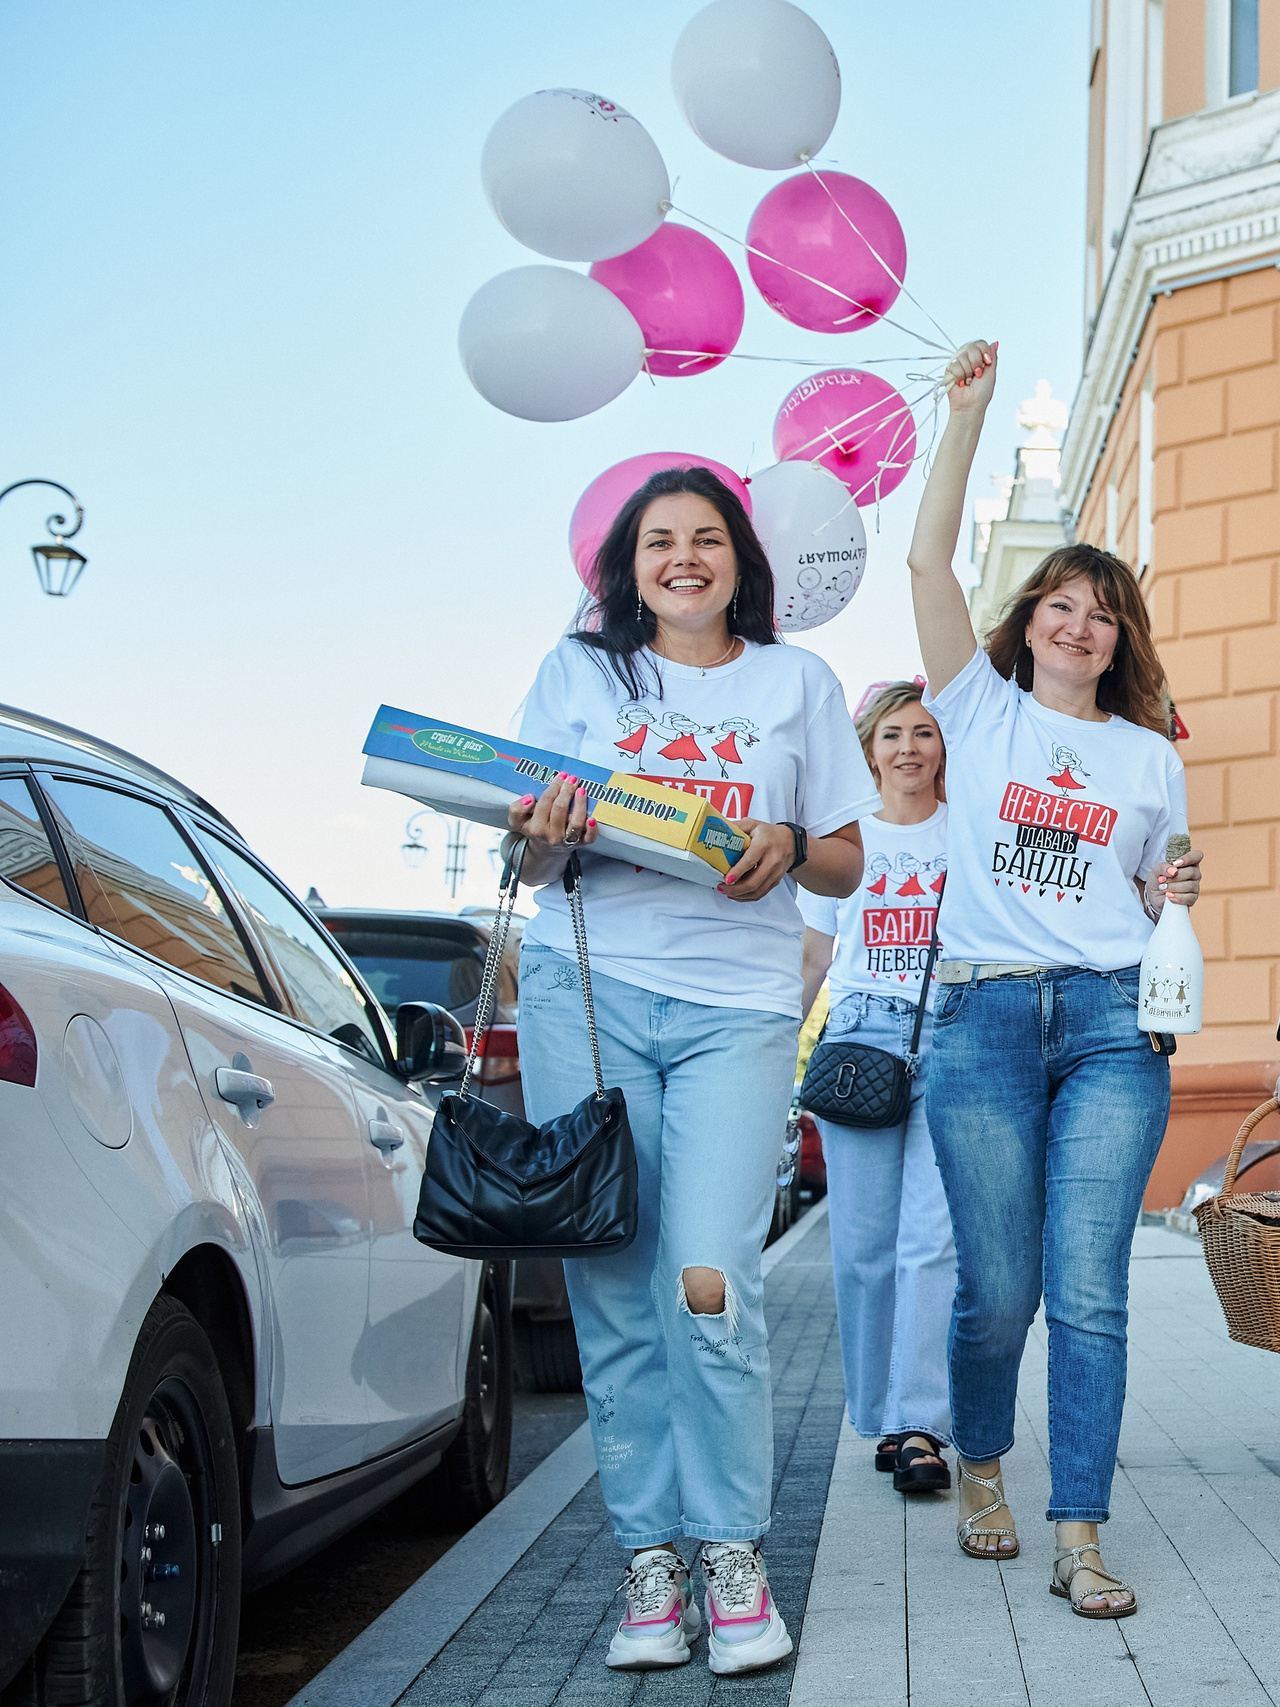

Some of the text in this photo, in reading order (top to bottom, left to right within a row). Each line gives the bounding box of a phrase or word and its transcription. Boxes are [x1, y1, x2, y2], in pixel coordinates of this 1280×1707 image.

[420, 740, 443, 752] Made
[452, 747, 480, 761] Russia
[430, 731, 484, 752] crystal & glass
[624, 793, 677, 821] НАБОР
[1002, 784, 1112, 843] НЕВЕСТА
[1018, 825, 1075, 853] ГЛАВАРЬ
[991, 842, 1092, 890] БАНДЫ
[866, 910, 935, 945] БАНД
[1148, 1007, 1183, 1018] ДЕВИЧНИК
